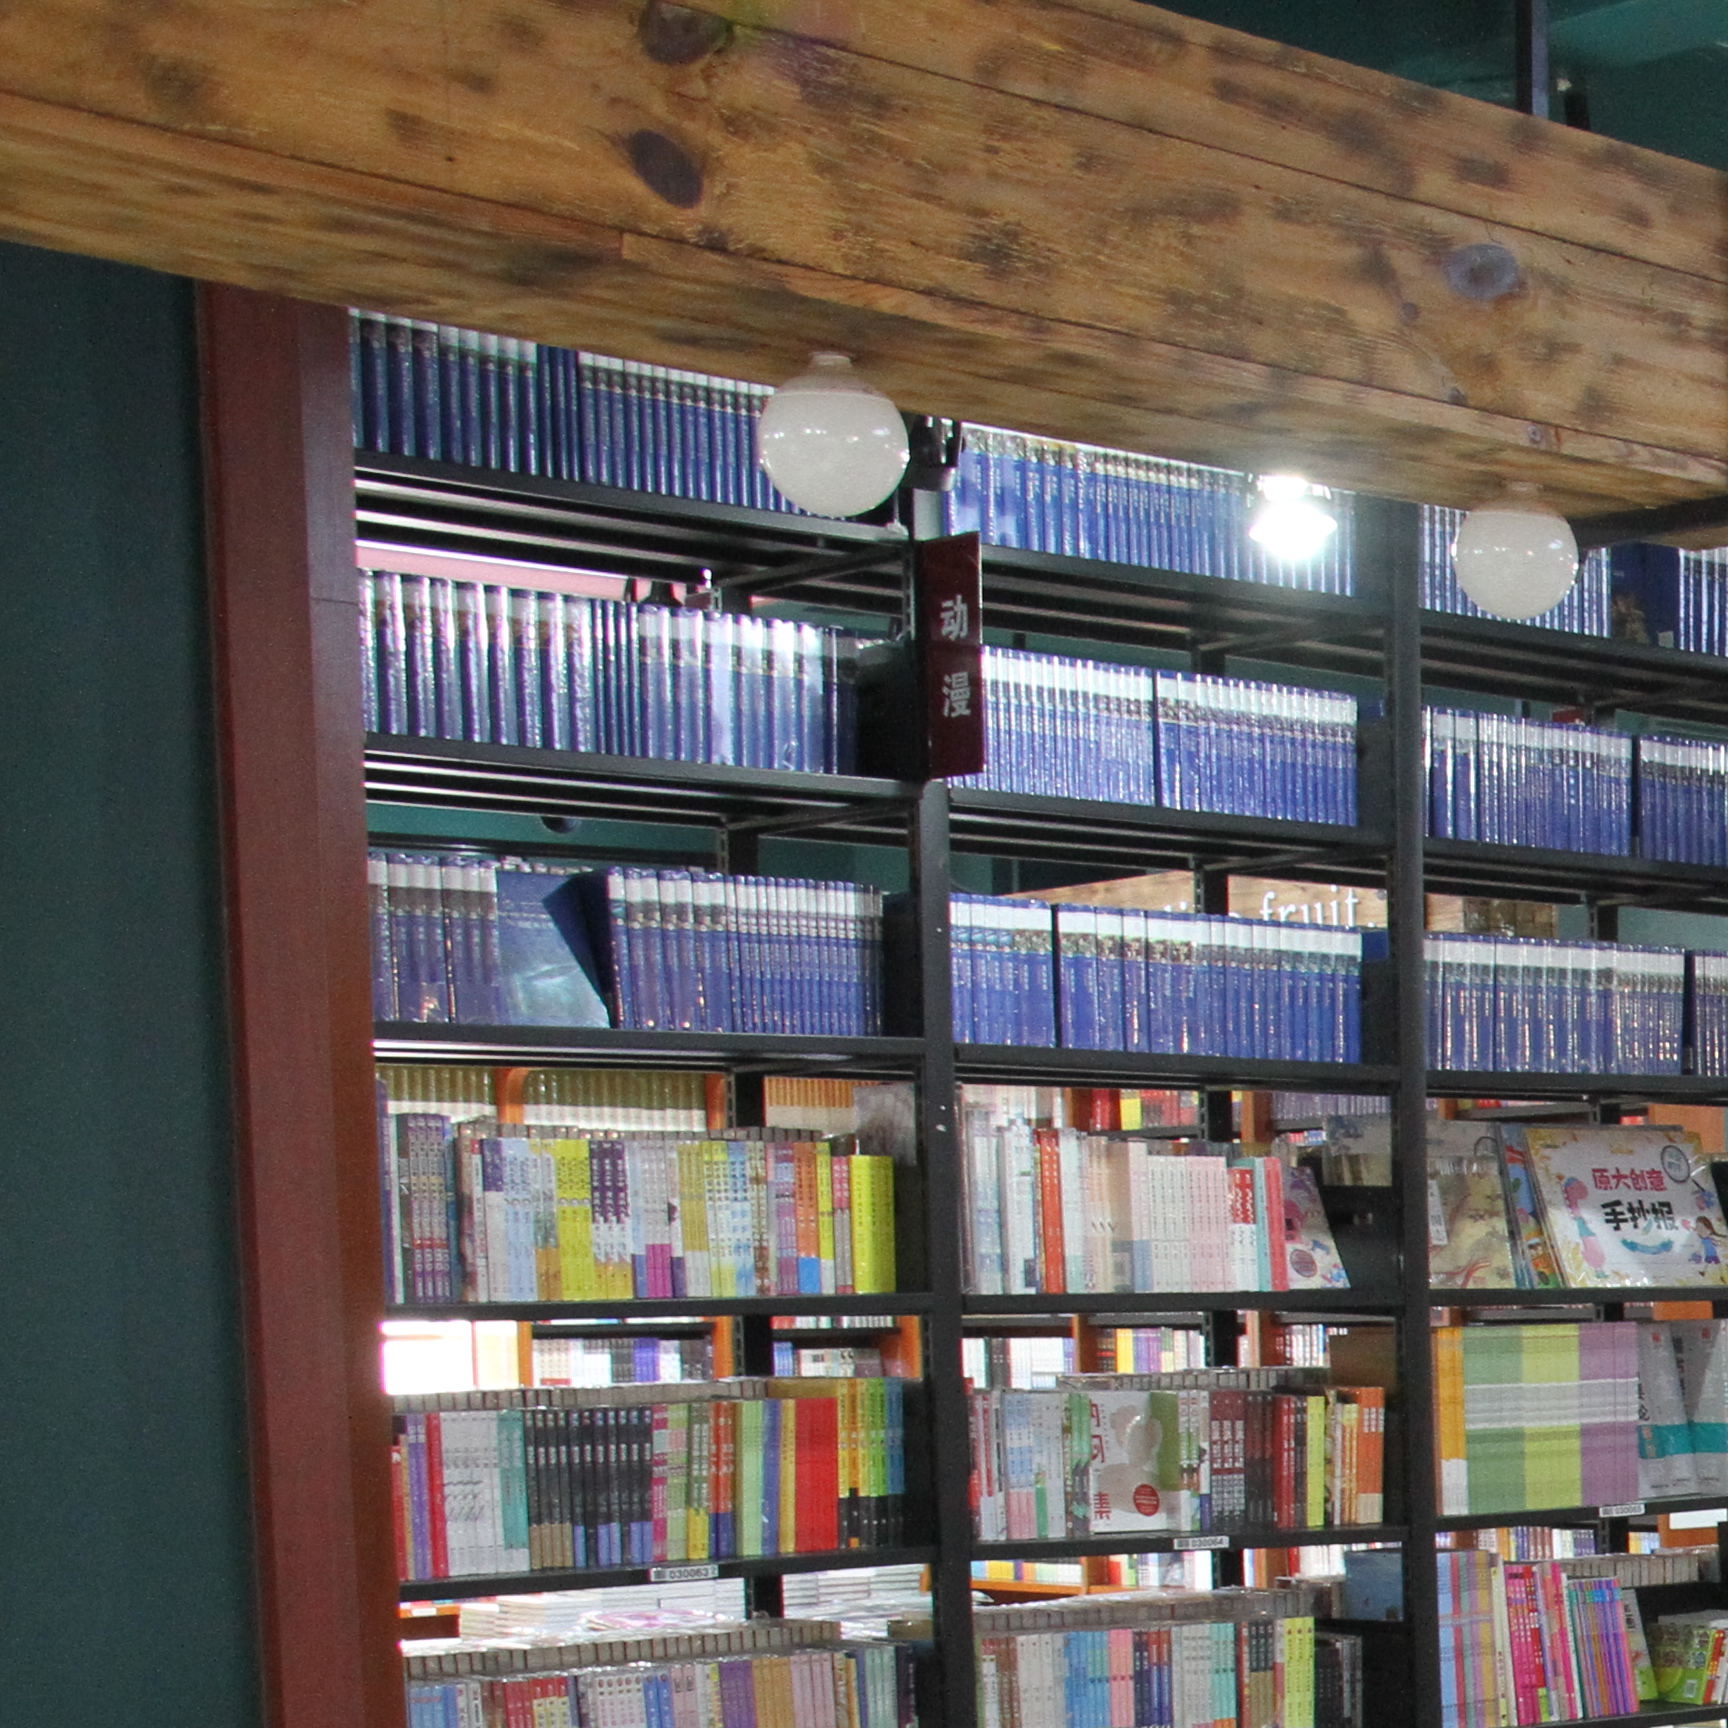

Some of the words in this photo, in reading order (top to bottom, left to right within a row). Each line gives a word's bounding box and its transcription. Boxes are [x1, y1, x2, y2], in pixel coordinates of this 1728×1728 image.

[940, 594, 972, 719] 动漫
[1591, 1166, 1668, 1193] 原大创意
[1601, 1200, 1681, 1233] 手抄报
